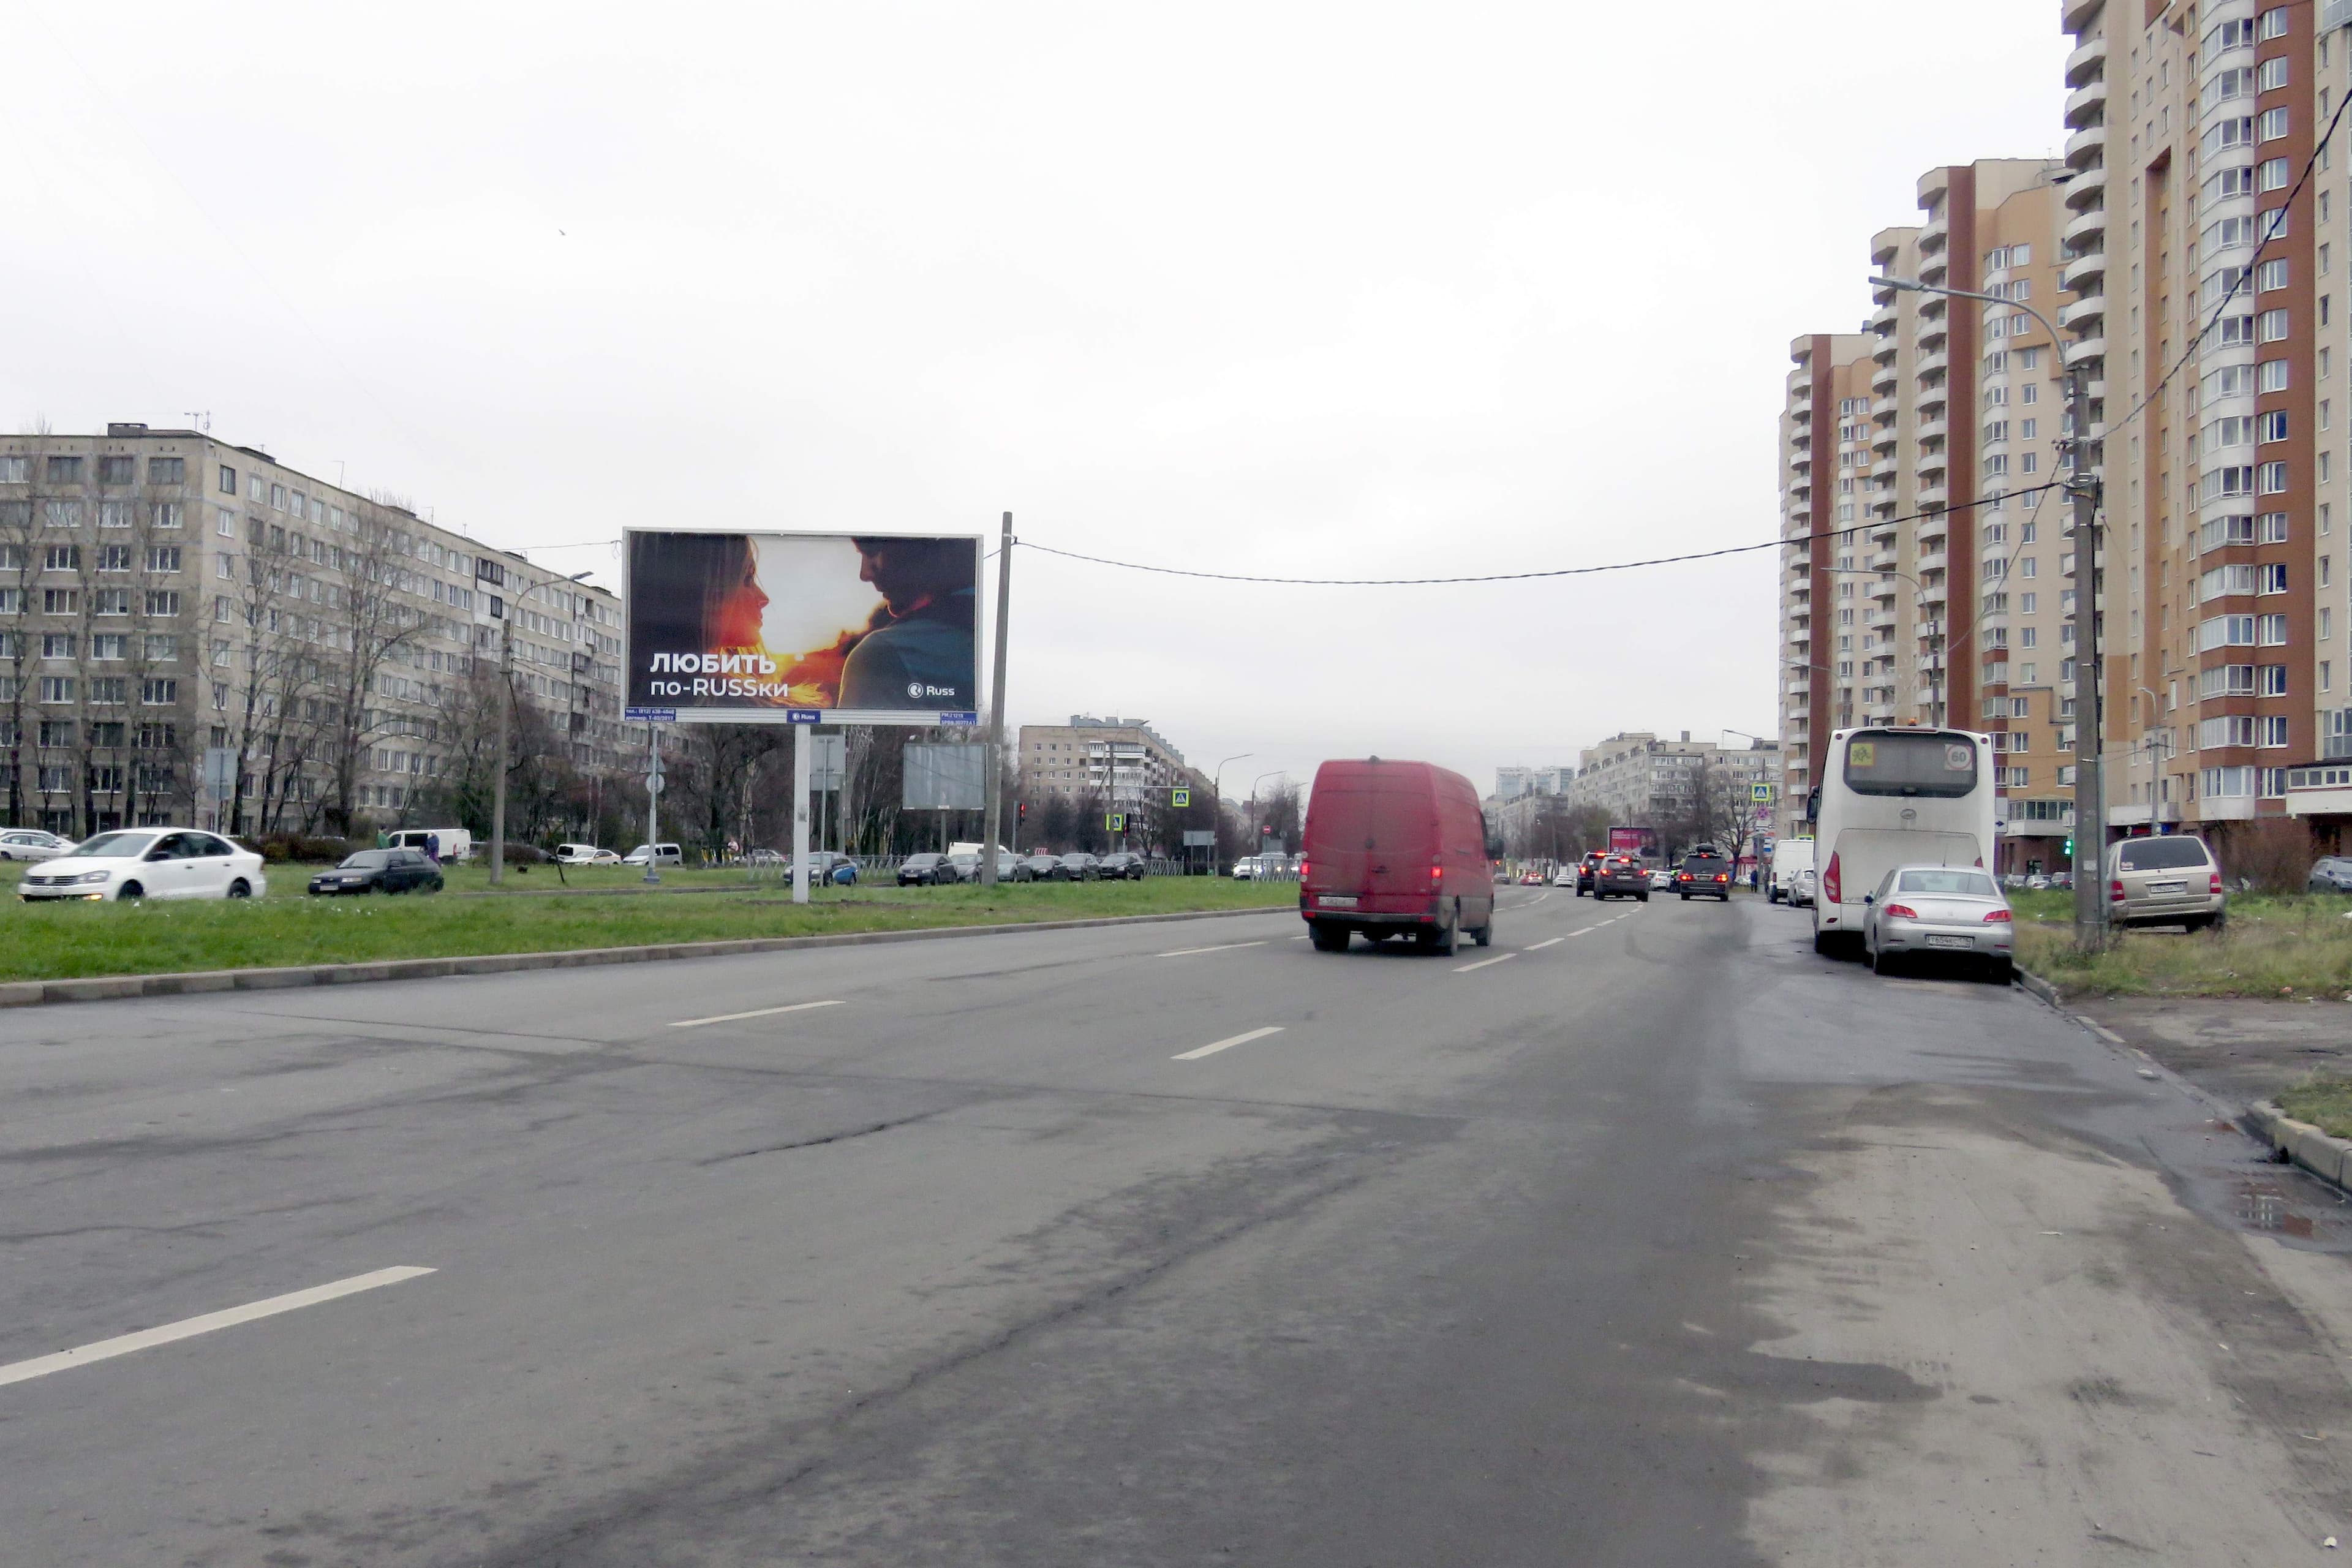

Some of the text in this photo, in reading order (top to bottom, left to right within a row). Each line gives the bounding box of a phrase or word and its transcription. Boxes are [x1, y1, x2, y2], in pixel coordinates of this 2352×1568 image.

[650, 653, 777, 674] ЛЮБИТЬ
[650, 678, 788, 697] по-RUSSки
[926, 685, 955, 696] Russ
[1951, 752, 1967, 762] 60
